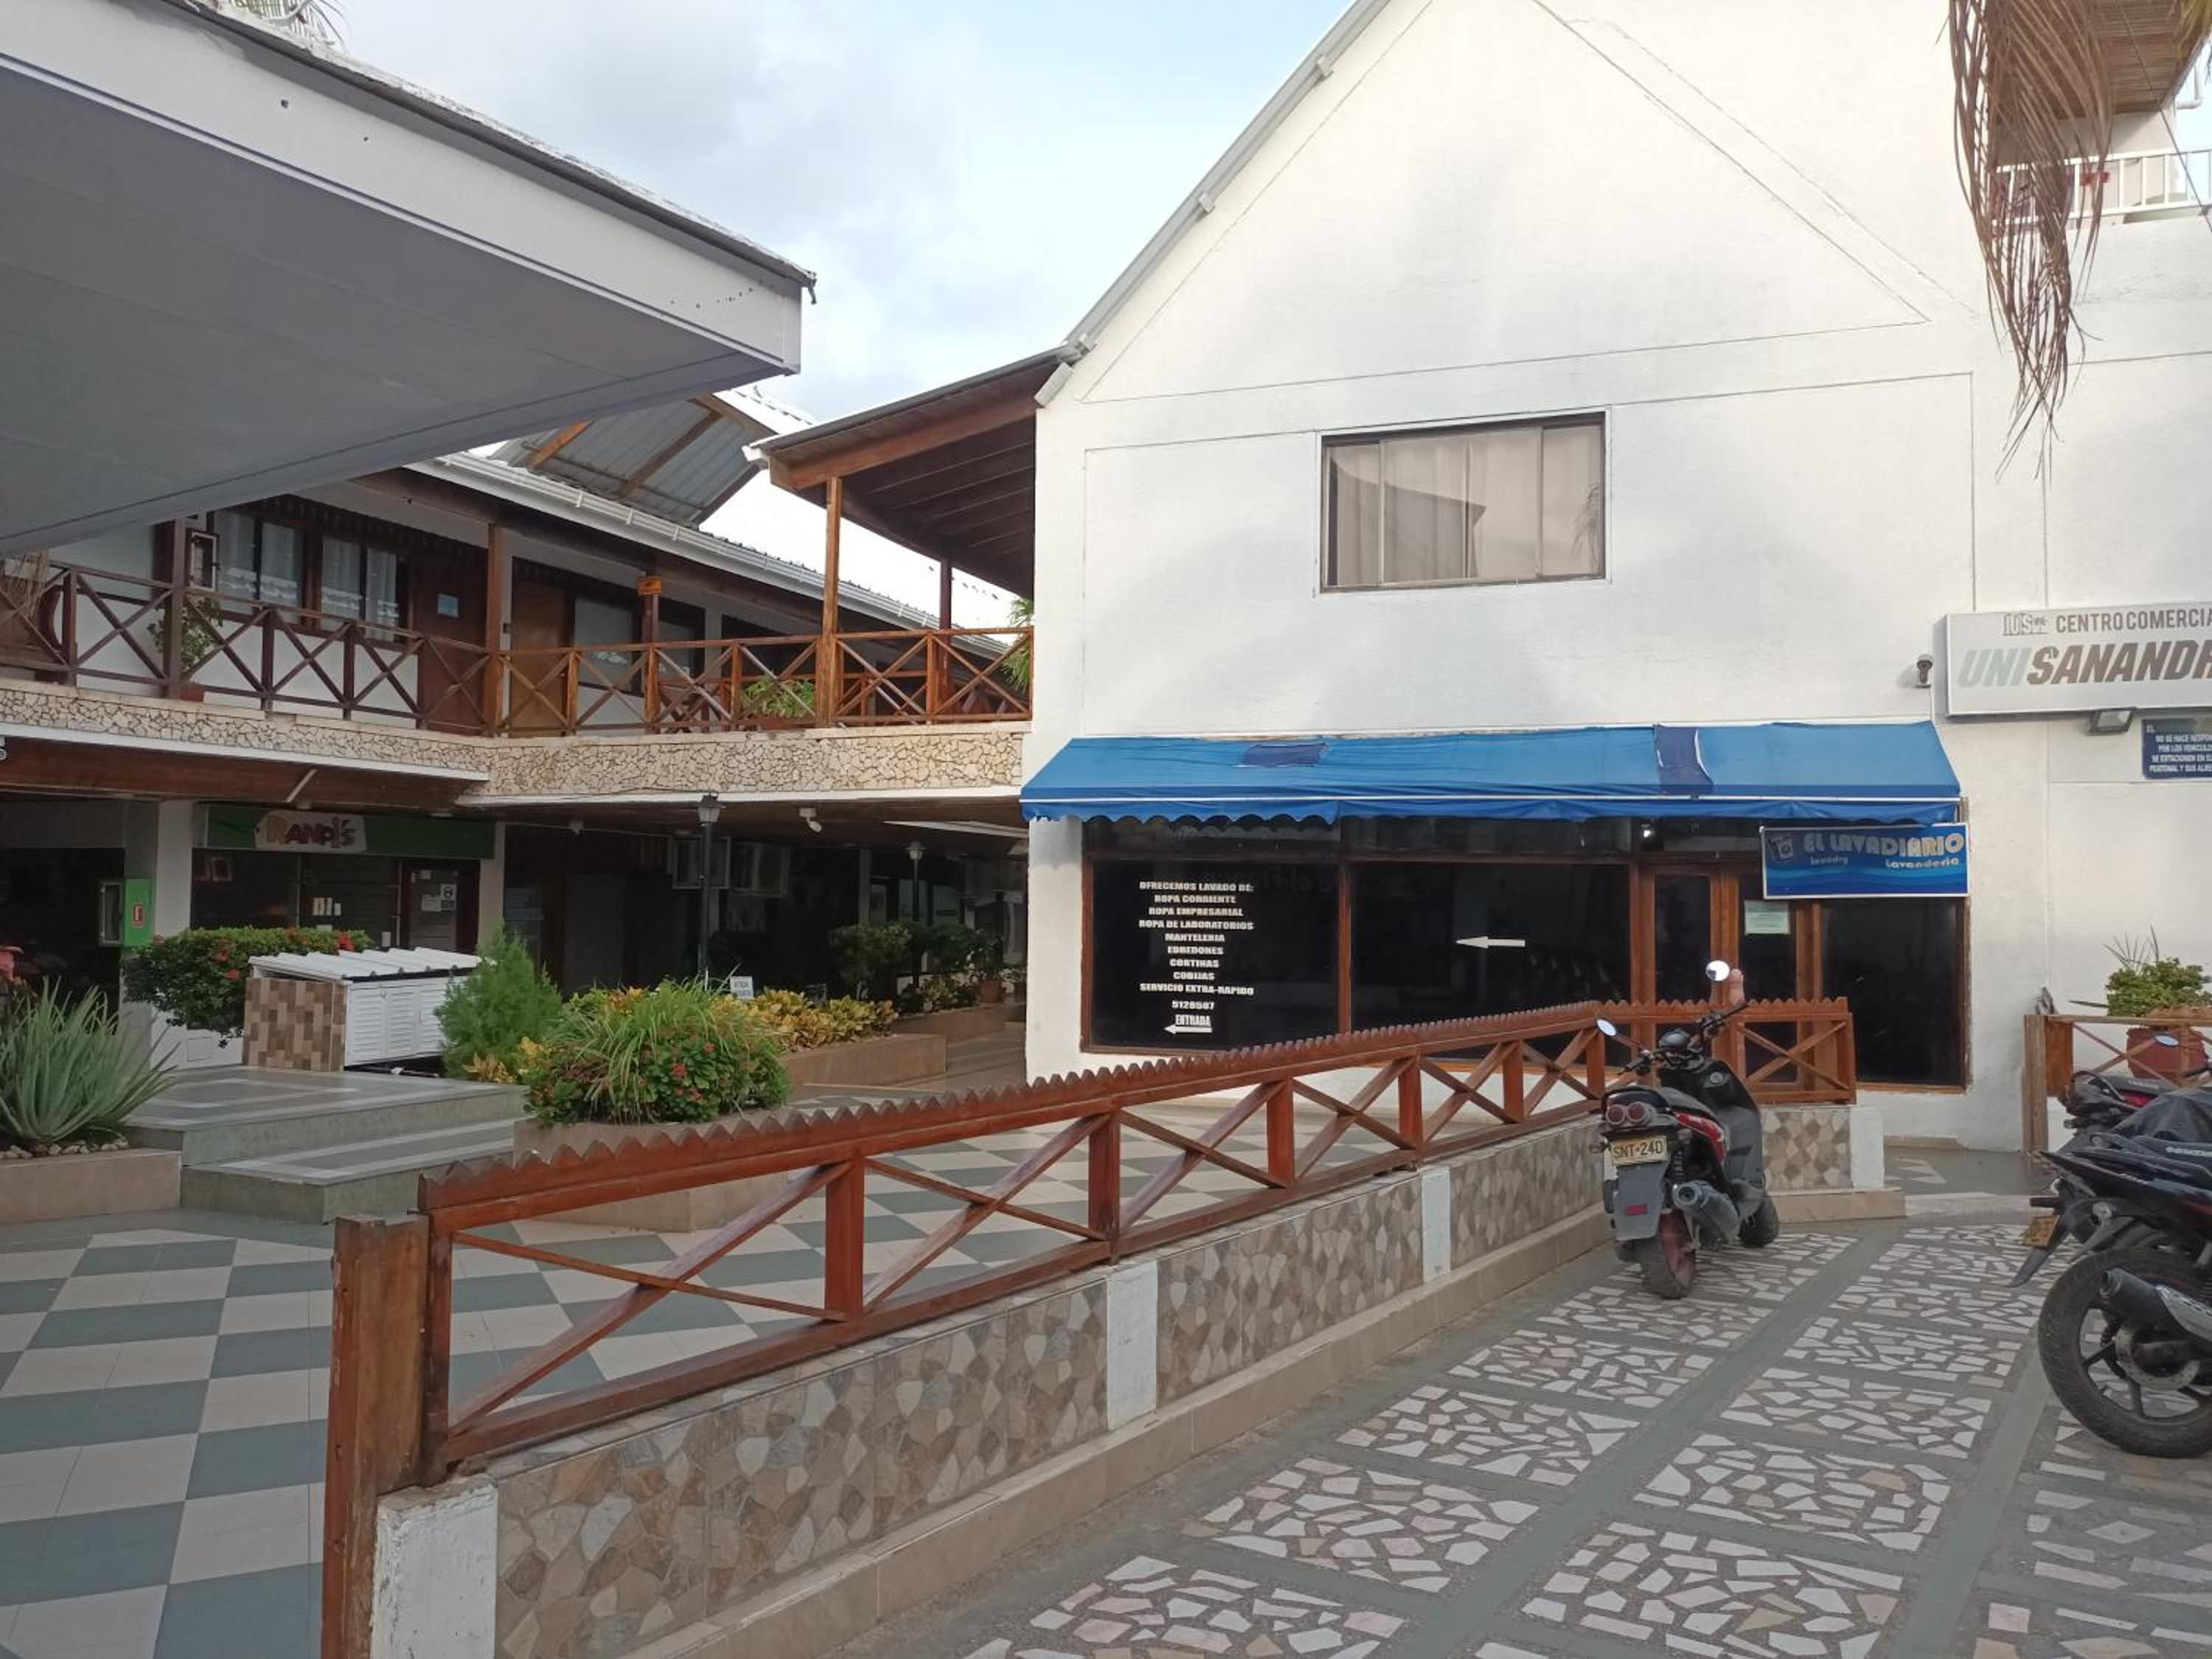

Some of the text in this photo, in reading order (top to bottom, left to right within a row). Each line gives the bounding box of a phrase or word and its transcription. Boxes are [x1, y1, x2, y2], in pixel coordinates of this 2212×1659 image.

[2056, 611, 2123, 633] CENTRO
[1139, 881, 1197, 891] OFRECEMOS
[1198, 883, 1237, 891] LAVADO
[1154, 894, 1237, 903] ROPA CORRIENTE
[1176, 908, 1244, 917] EMPRESARIAL
[1138, 920, 1254, 930] ROPA DE LABORATORIOS
[1167, 946, 1224, 955] EDREDONES
[1169, 959, 1220, 968] CORTINAS
[1139, 983, 1184, 992] SERVICIO
[1175, 1014, 1212, 1026] ENTRADA
